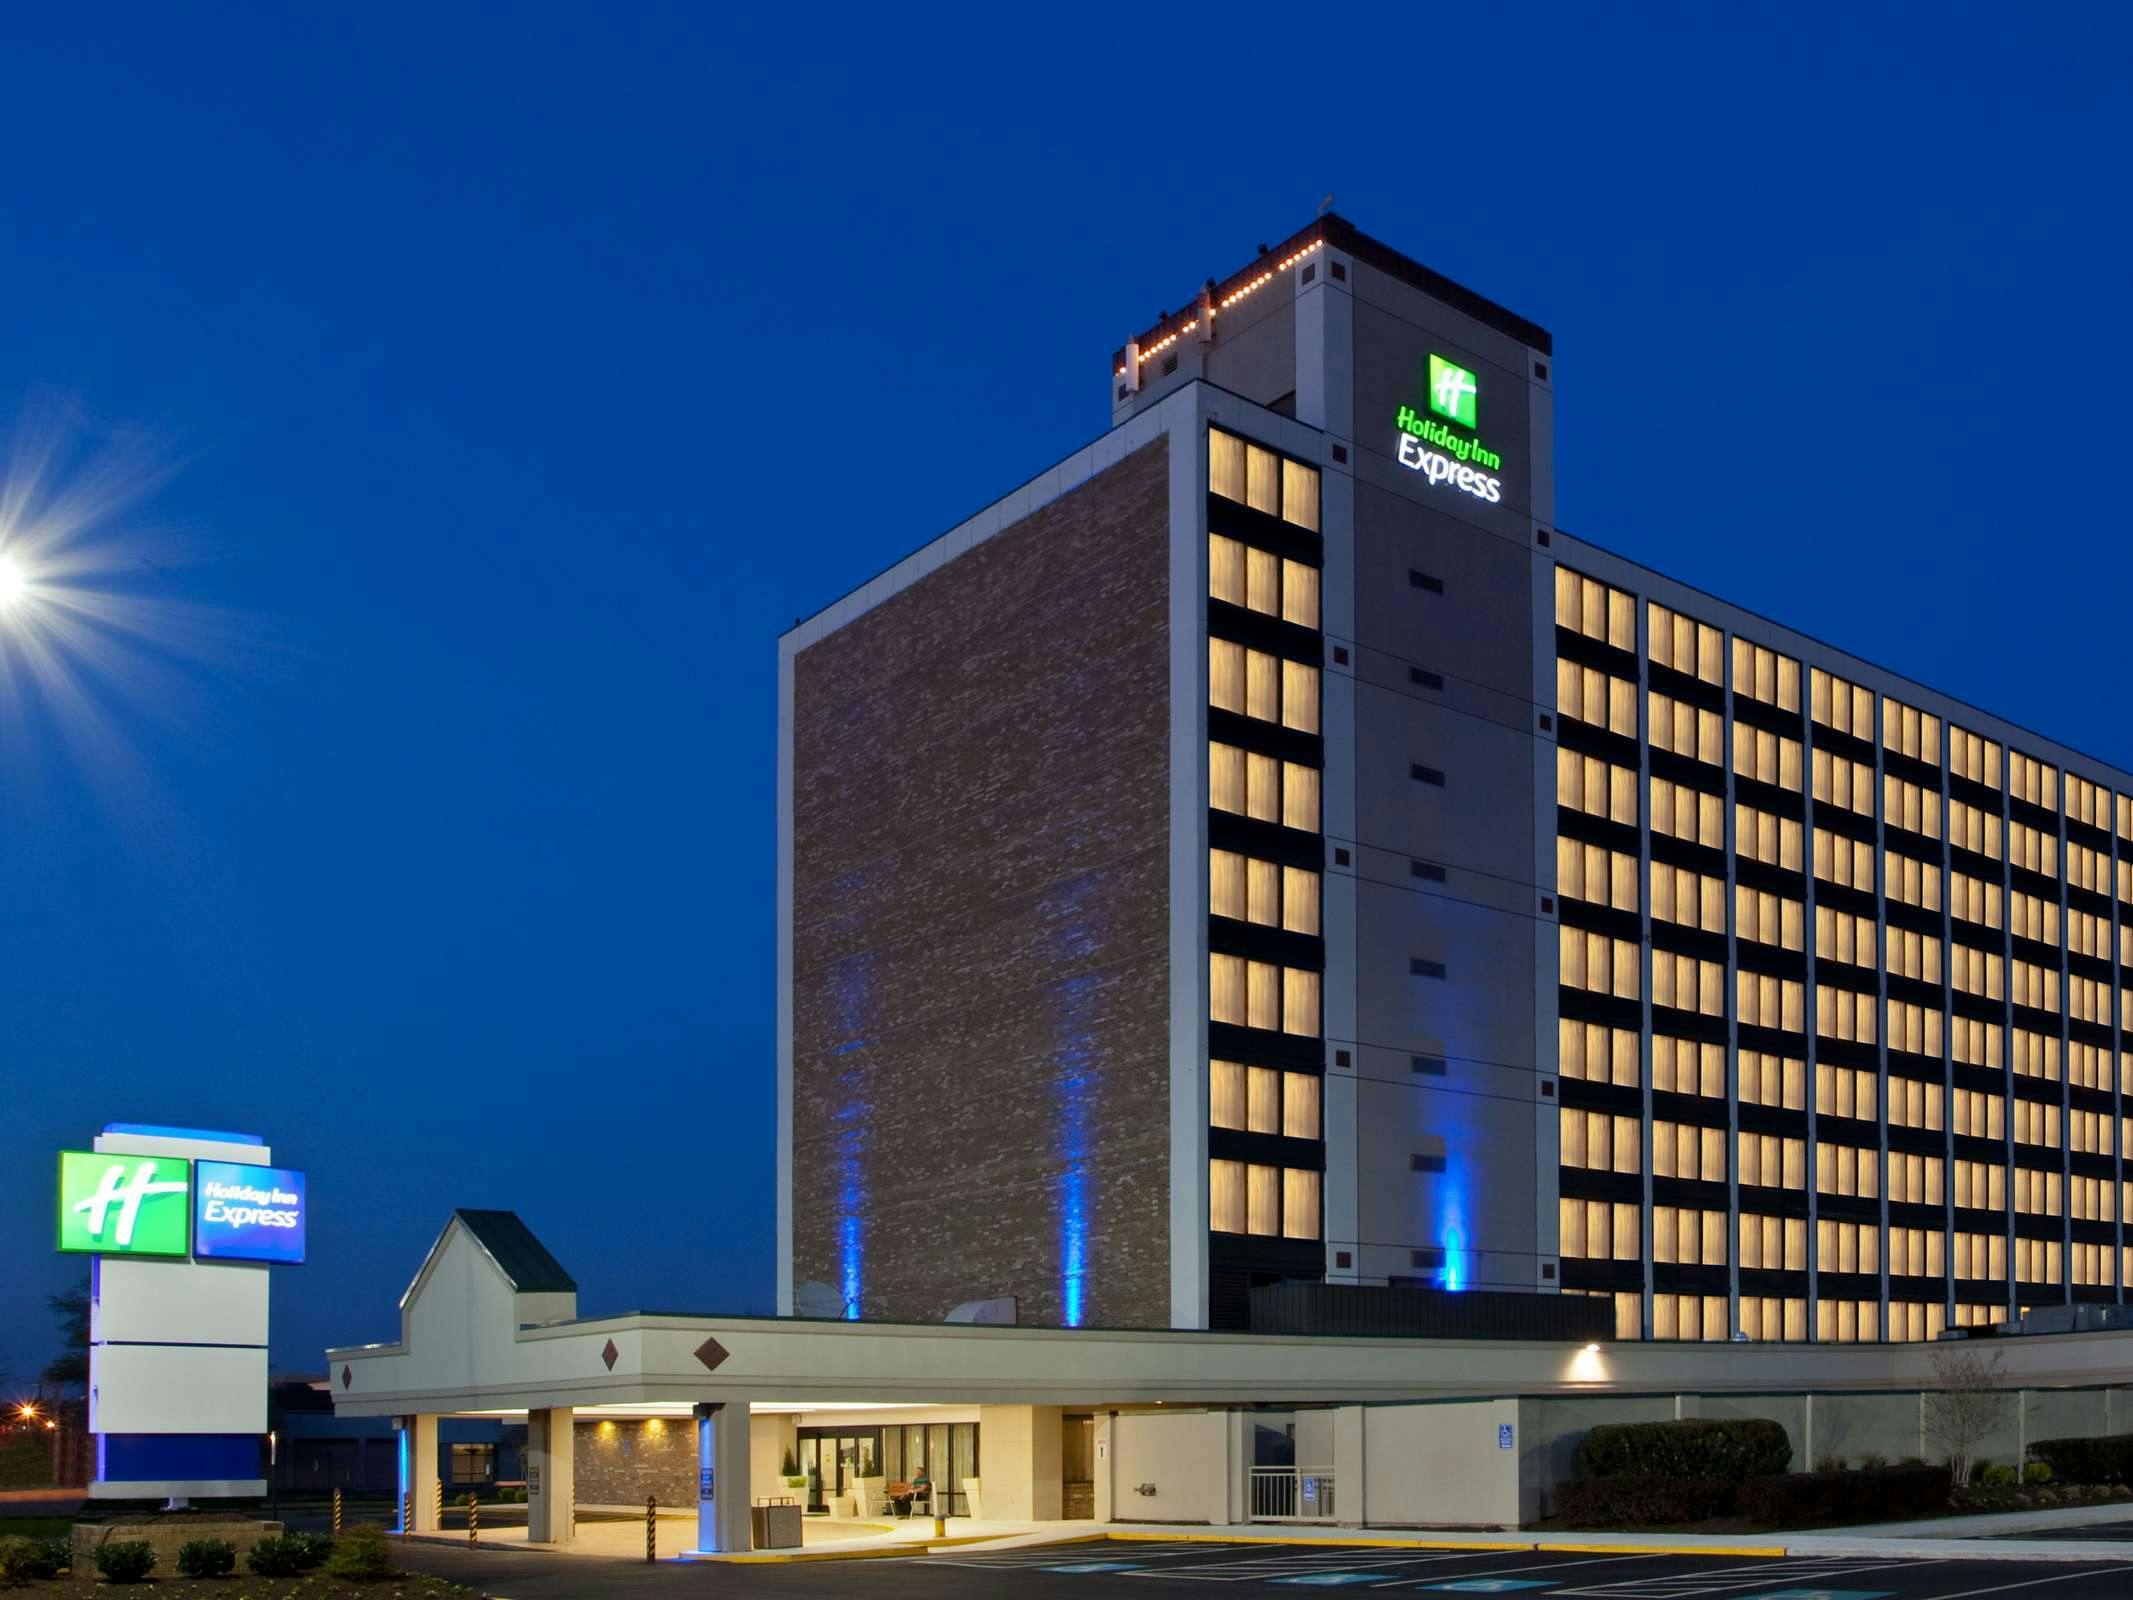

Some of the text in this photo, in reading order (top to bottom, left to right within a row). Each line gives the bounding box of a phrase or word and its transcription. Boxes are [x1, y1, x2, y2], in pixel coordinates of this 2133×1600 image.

[1397, 406, 1500, 470] Holiday Inn
[1397, 432, 1502, 503] Express
[204, 1200, 299, 1229] Express
[205, 1182, 298, 1206] Holiday Inn
